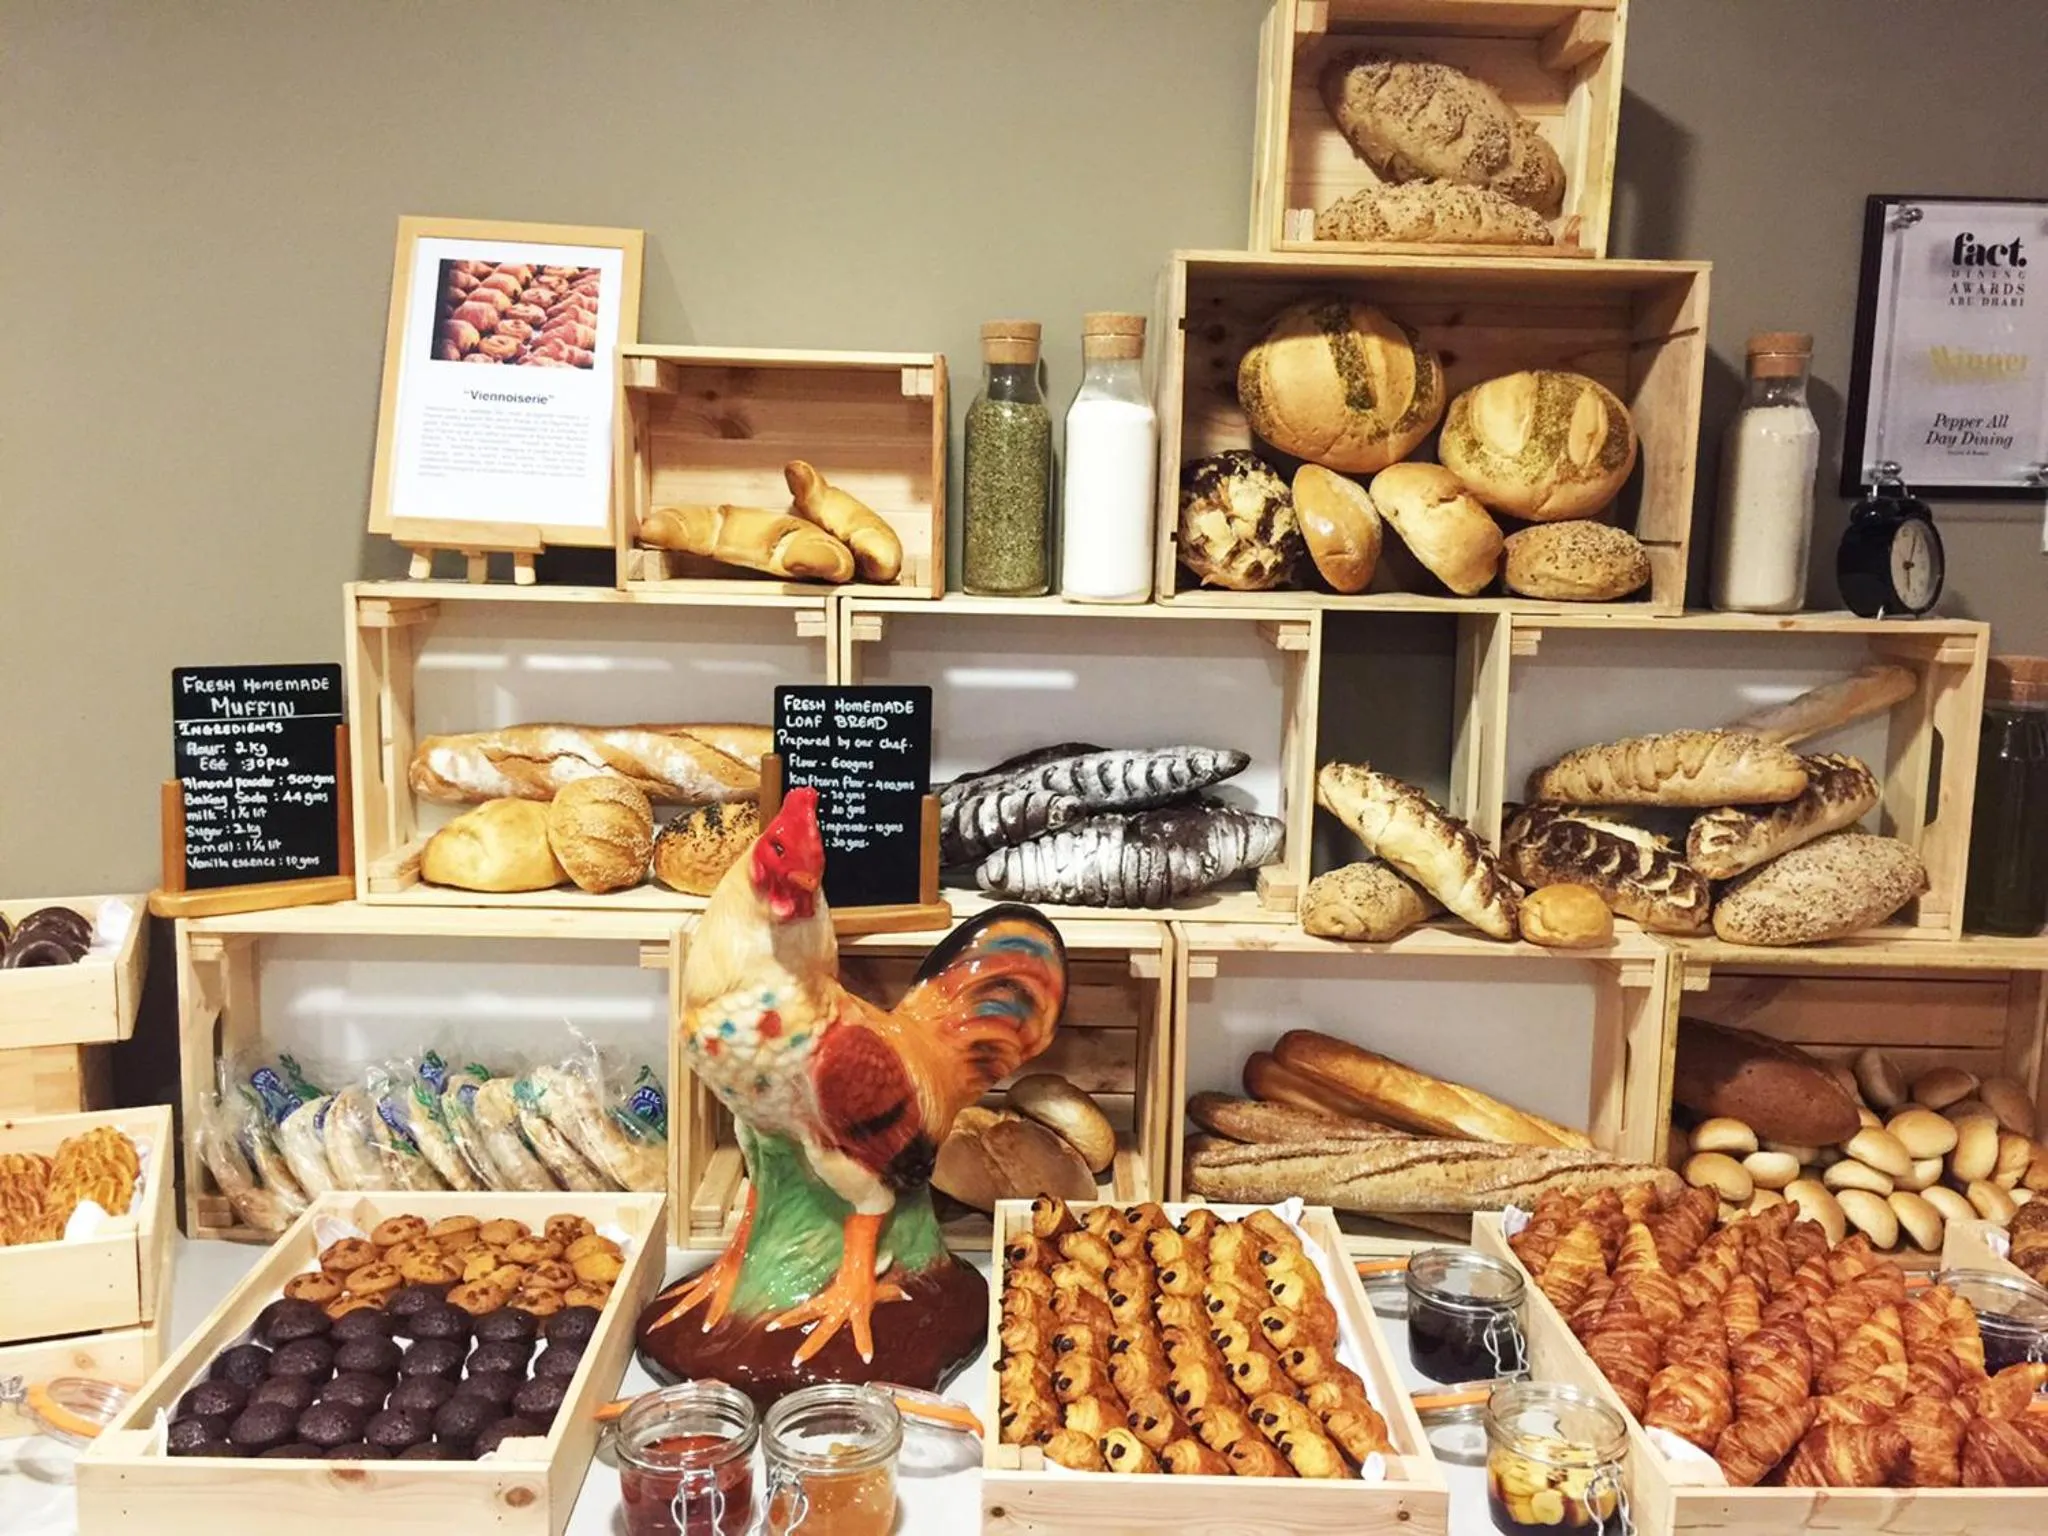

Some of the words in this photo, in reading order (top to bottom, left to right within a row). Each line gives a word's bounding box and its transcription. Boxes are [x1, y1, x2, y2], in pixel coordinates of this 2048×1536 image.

[1952, 232, 2027, 267] fact.
[1950, 282, 2025, 295] AWARDS
[1933, 412, 1984, 432] Pepper
[1985, 414, 2009, 429] All
[1925, 430, 1958, 449] Day
[1961, 430, 2014, 450] Dining
[183, 676, 235, 693] FRESH
[211, 696, 296, 717] MUFFIN
[784, 695, 825, 711] FRESH
[786, 715, 822, 727] LOAF
[834, 715, 887, 730] BREAD
[777, 729, 829, 749] Prepared
[838, 736, 850, 749] by
[855, 739, 873, 748] our
[789, 753, 817, 767] Flour
[186, 809, 216, 821] milk
